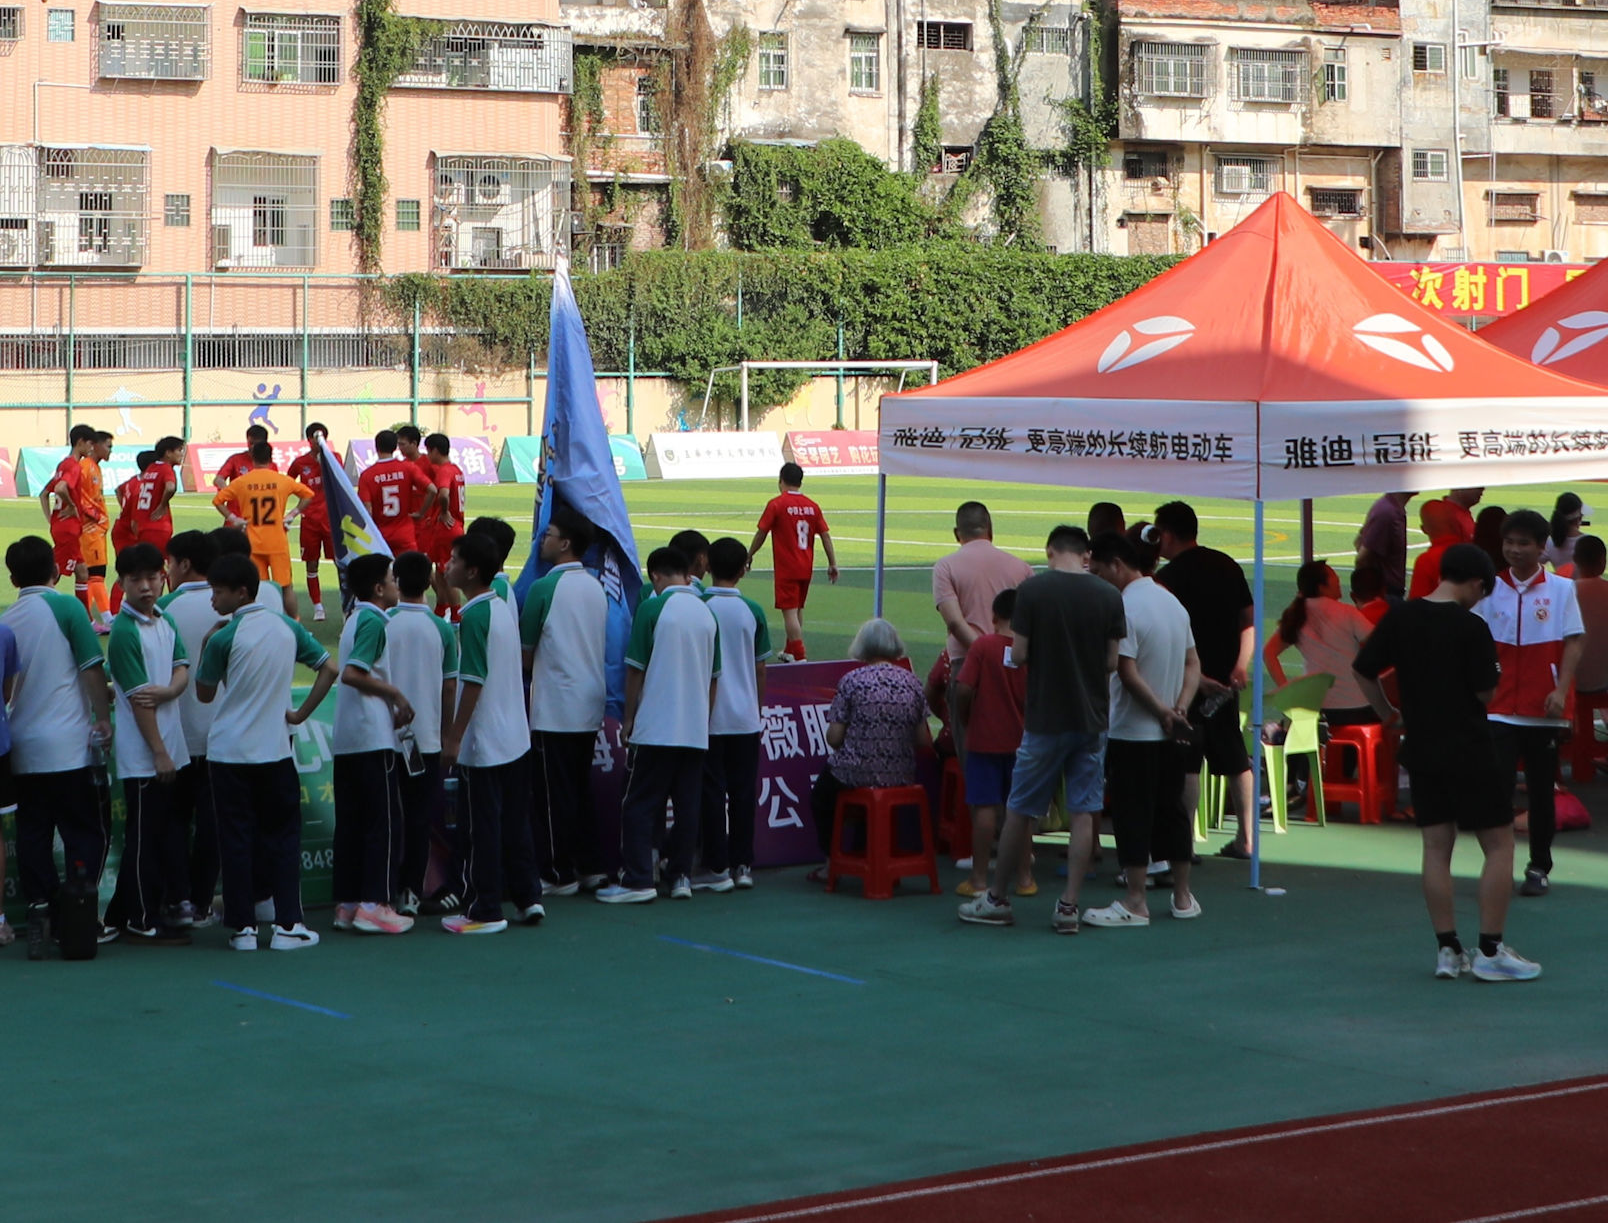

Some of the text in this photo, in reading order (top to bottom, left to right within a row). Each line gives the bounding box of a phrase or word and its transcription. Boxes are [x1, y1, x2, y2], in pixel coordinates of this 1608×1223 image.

[1025, 426, 1234, 463] 更高端的长续航电动车
[1284, 435, 1356, 470] 雅迪
[249, 496, 277, 526] 12
[381, 485, 402, 517] 5
[796, 519, 810, 551] 8
